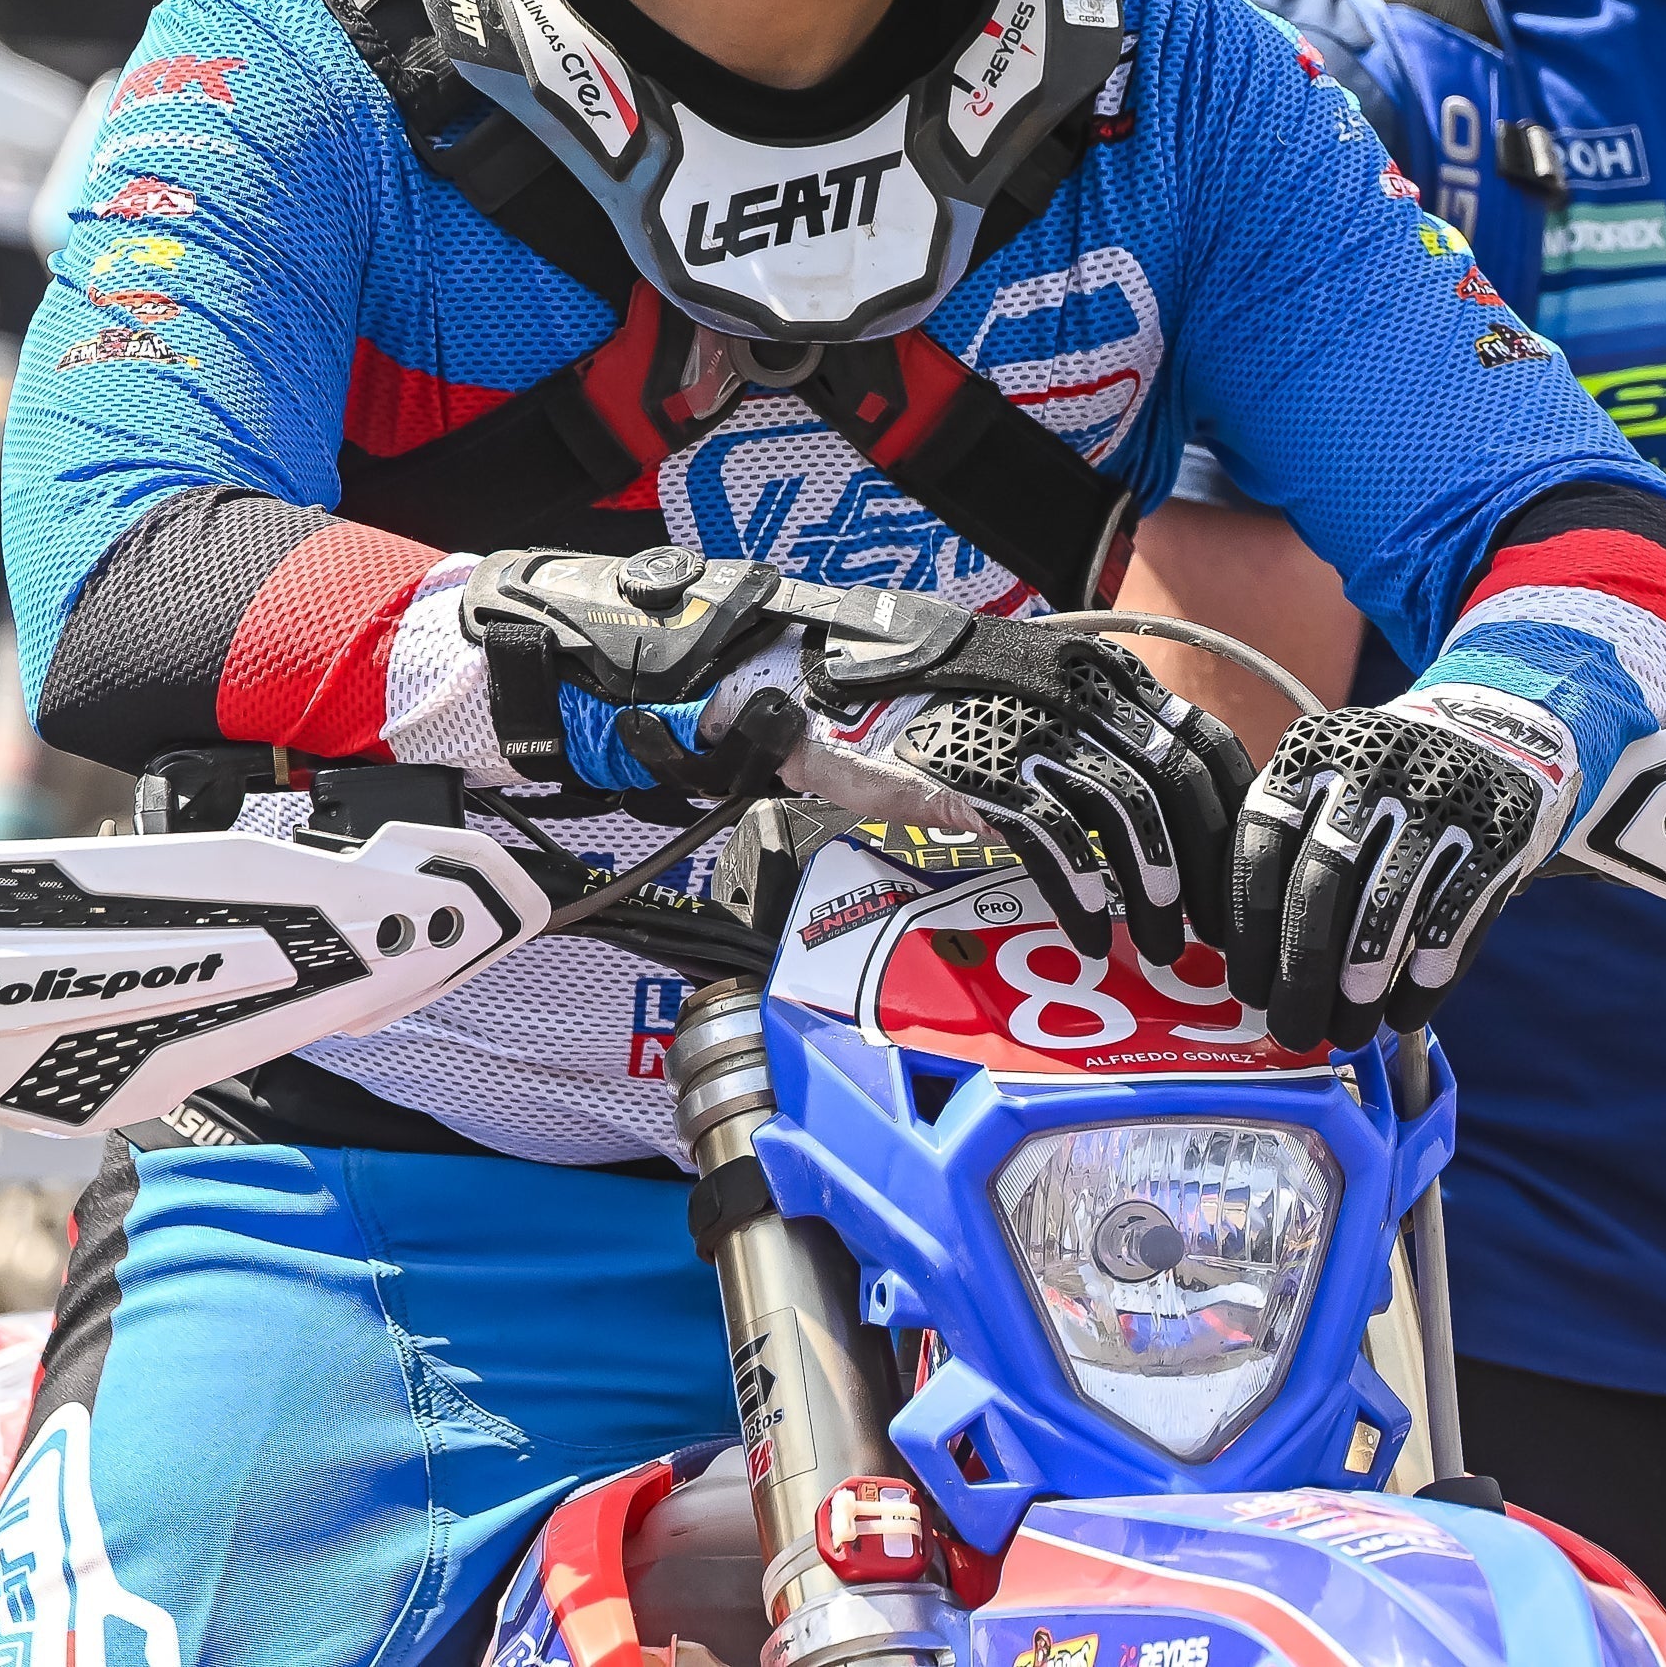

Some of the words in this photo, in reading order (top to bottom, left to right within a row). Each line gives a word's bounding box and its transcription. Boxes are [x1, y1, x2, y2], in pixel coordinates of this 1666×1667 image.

[981, 1, 1037, 89] REYDES
[684, 149, 904, 267] LEATT
[506, 742, 528, 754] FIVE
[530, 740, 552, 753] FIVE
[811, 881, 916, 920] SUPER
[979, 900, 1017, 914] PRO
[995, 929, 1268, 1050] 89
[1085, 1050, 1178, 1068] ALFREDO
[1182, 1050, 1257, 1065] GOMEZ
